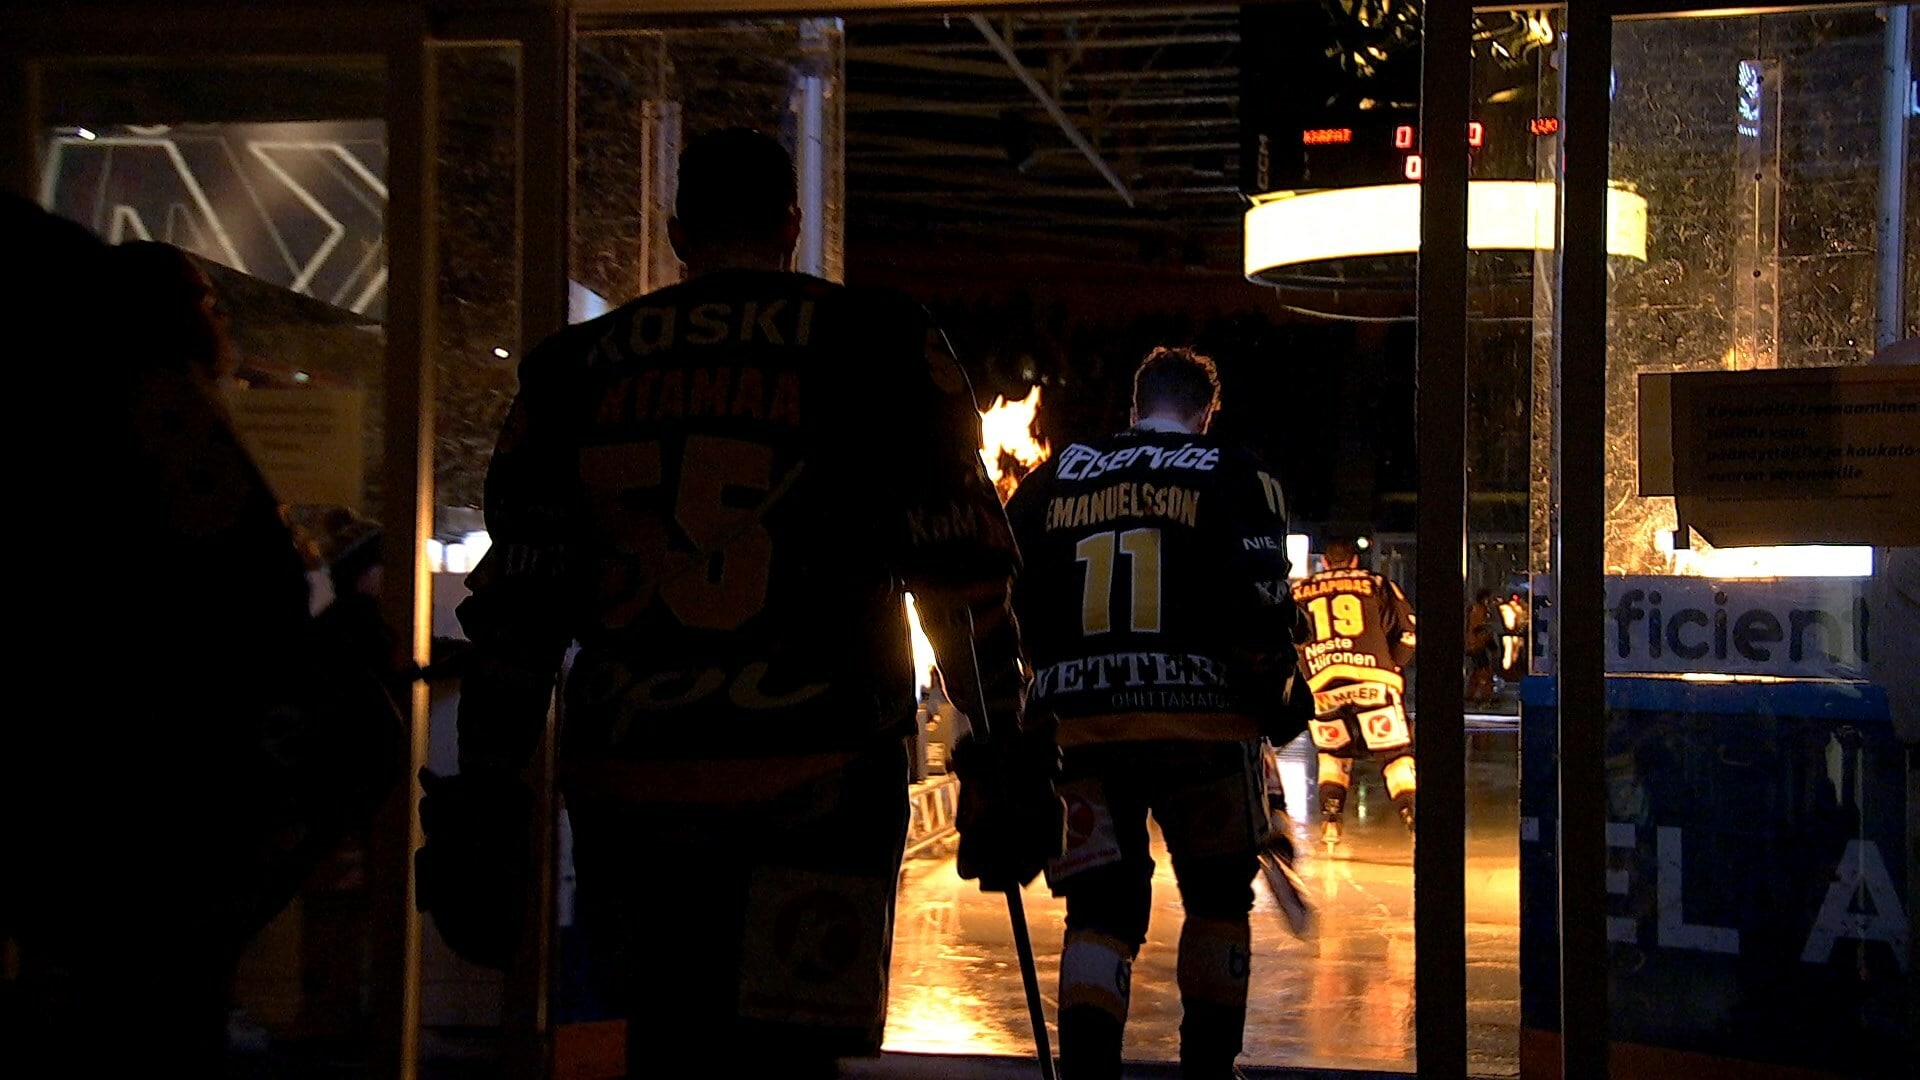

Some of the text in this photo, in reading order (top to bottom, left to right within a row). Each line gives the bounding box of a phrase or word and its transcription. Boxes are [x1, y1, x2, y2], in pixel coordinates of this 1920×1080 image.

[1075, 527, 1162, 637] 11
[1307, 594, 1364, 641] 19
[1305, 637, 1353, 659] Neste
